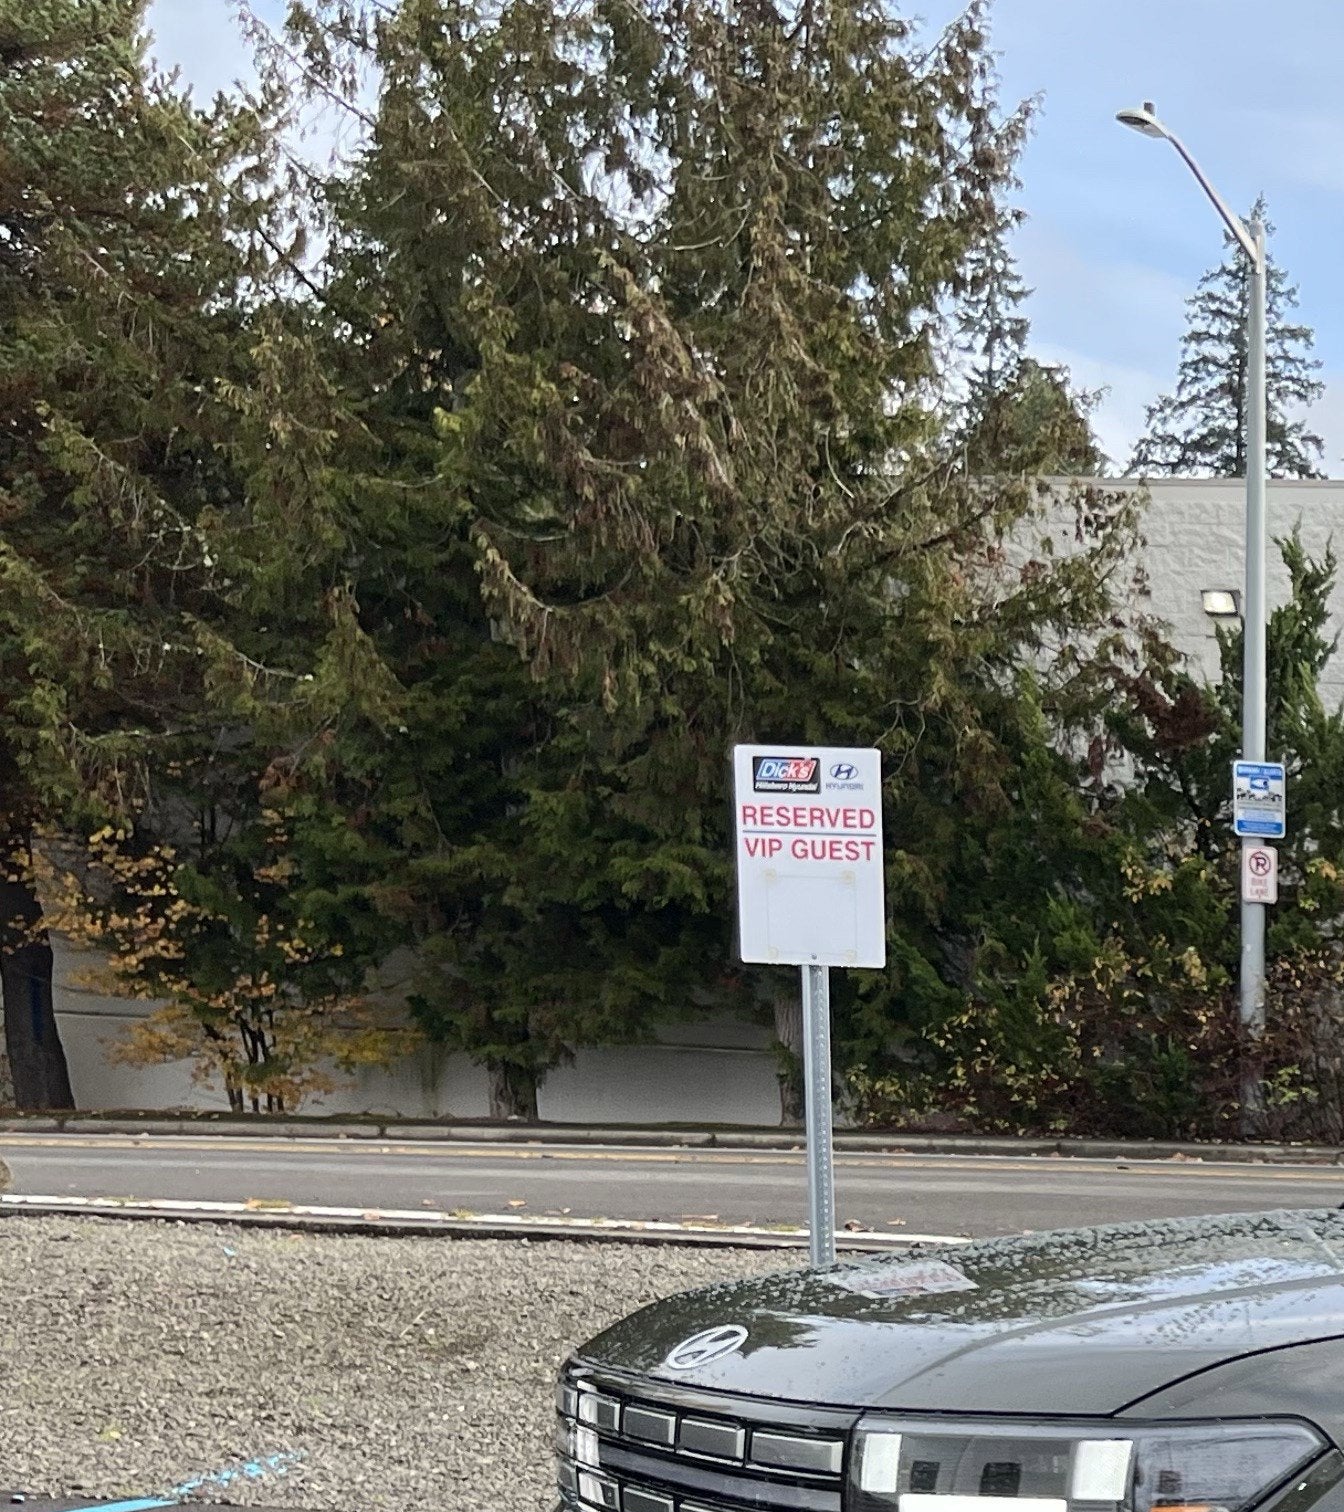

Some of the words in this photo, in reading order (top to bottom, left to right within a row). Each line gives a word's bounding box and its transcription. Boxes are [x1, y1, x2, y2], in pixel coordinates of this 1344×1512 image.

[742, 805, 875, 829] RESERVED
[744, 838, 783, 859] VIP
[791, 839, 876, 861] GUEST
